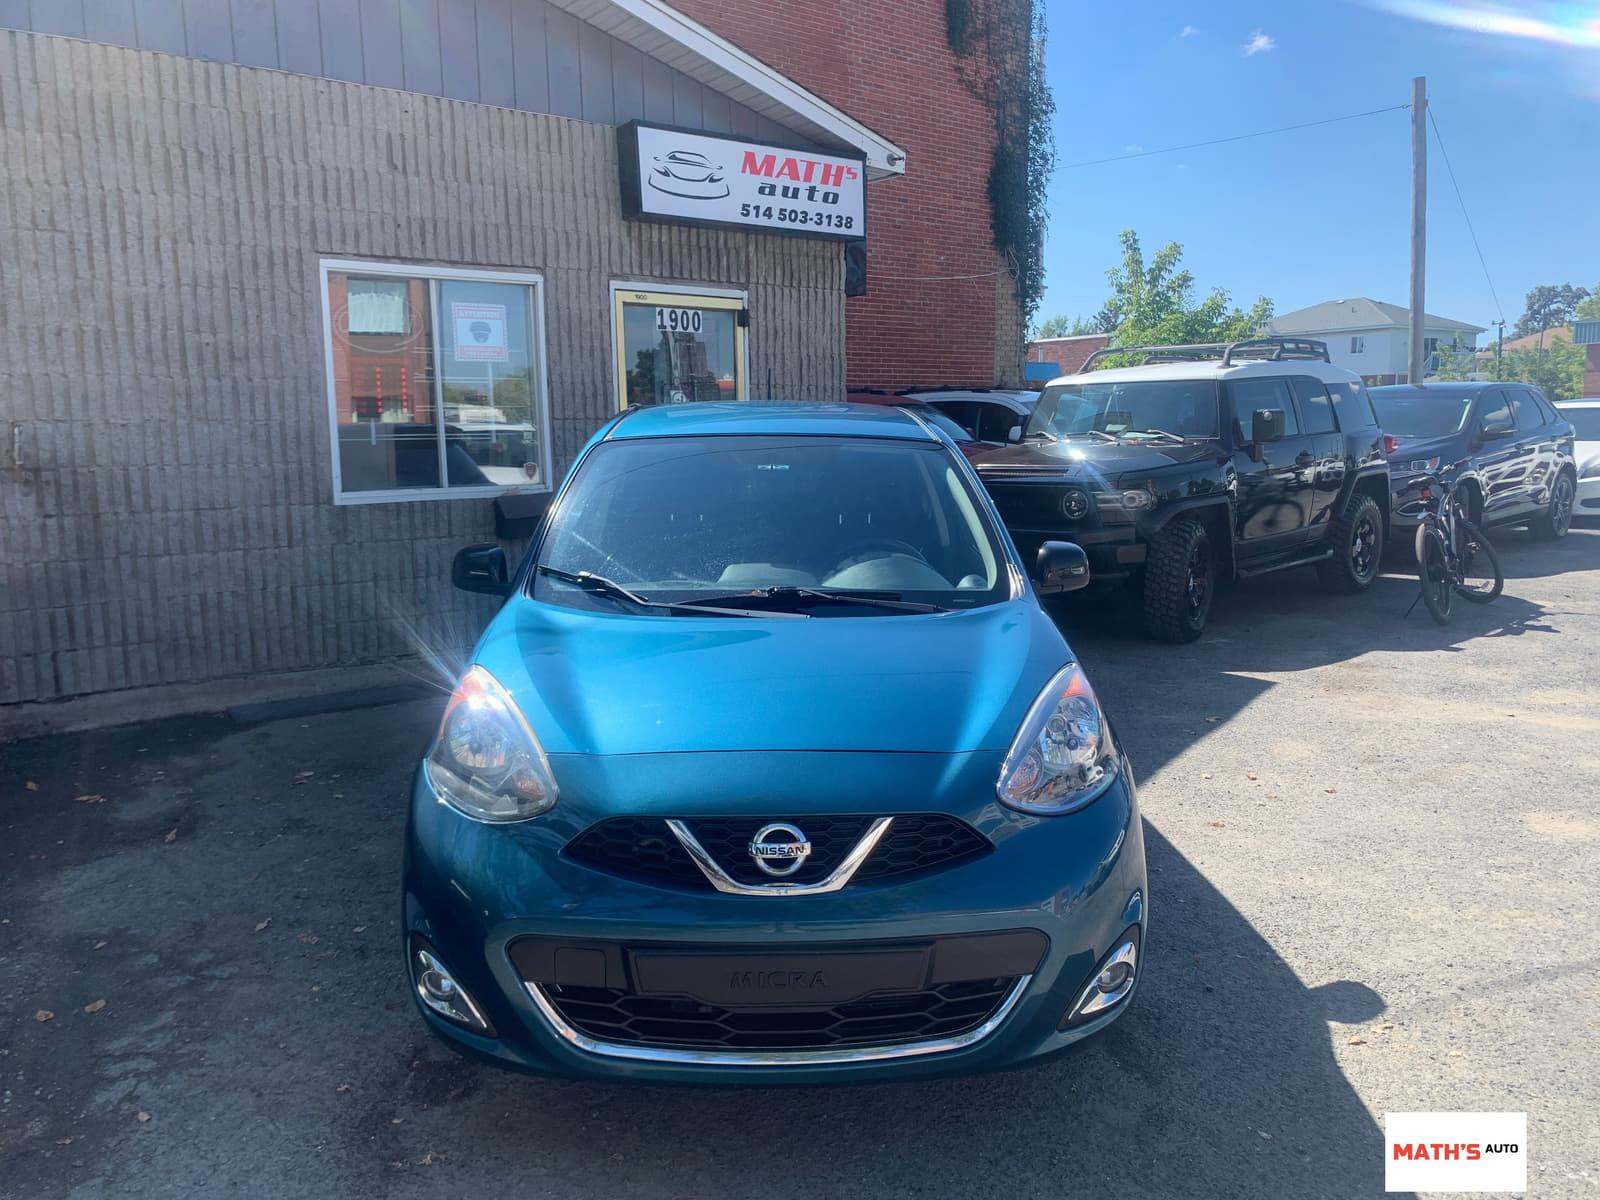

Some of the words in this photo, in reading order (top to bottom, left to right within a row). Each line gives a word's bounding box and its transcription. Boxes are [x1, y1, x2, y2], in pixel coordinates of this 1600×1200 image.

[758, 182, 839, 204] auto
[740, 203, 773, 219] 514
[778, 208, 853, 229] 503-3138
[657, 308, 701, 332] 1900
[754, 846, 805, 857] NISSAN
[730, 970, 826, 989] MICRA
